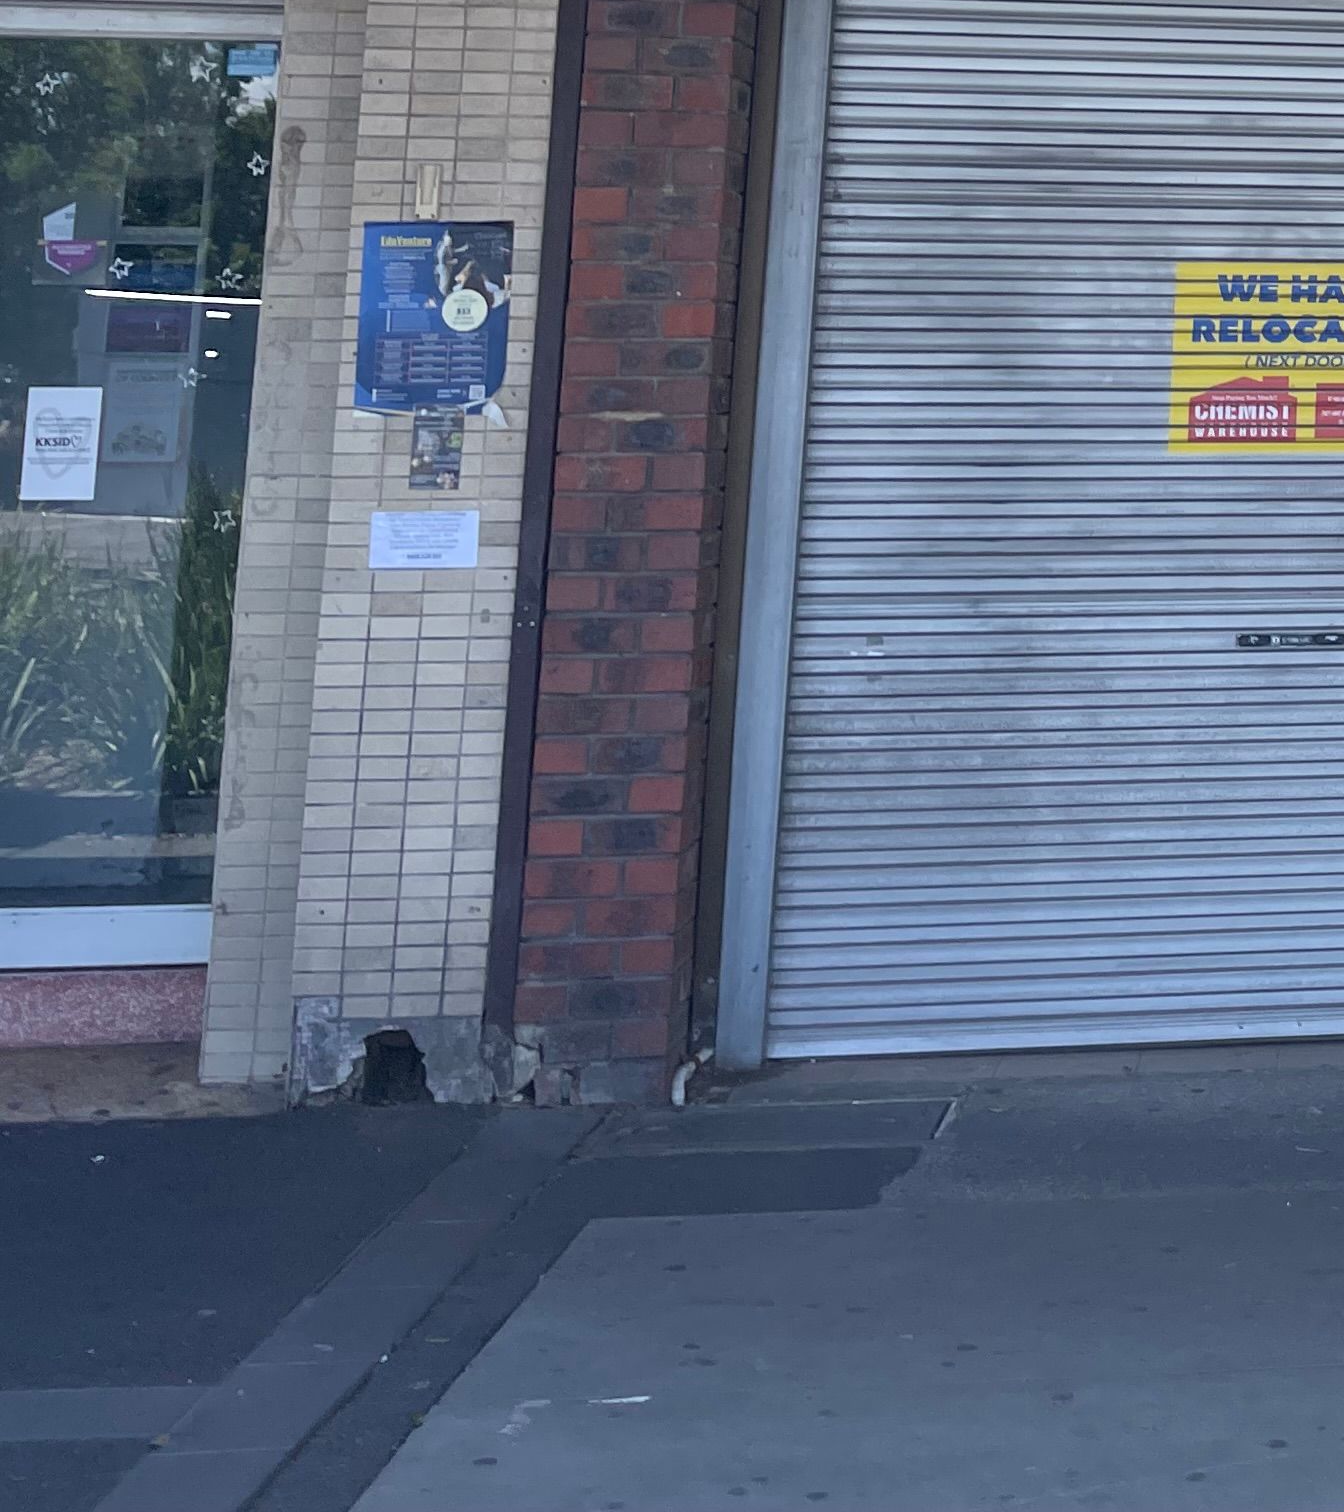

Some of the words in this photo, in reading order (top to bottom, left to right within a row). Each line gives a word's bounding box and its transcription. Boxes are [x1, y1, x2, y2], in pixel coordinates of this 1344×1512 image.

[1217, 274, 1279, 303] WE
[1194, 402, 1289, 420] CHEMIST
[1194, 422, 1289, 437] WAREHOUSE
